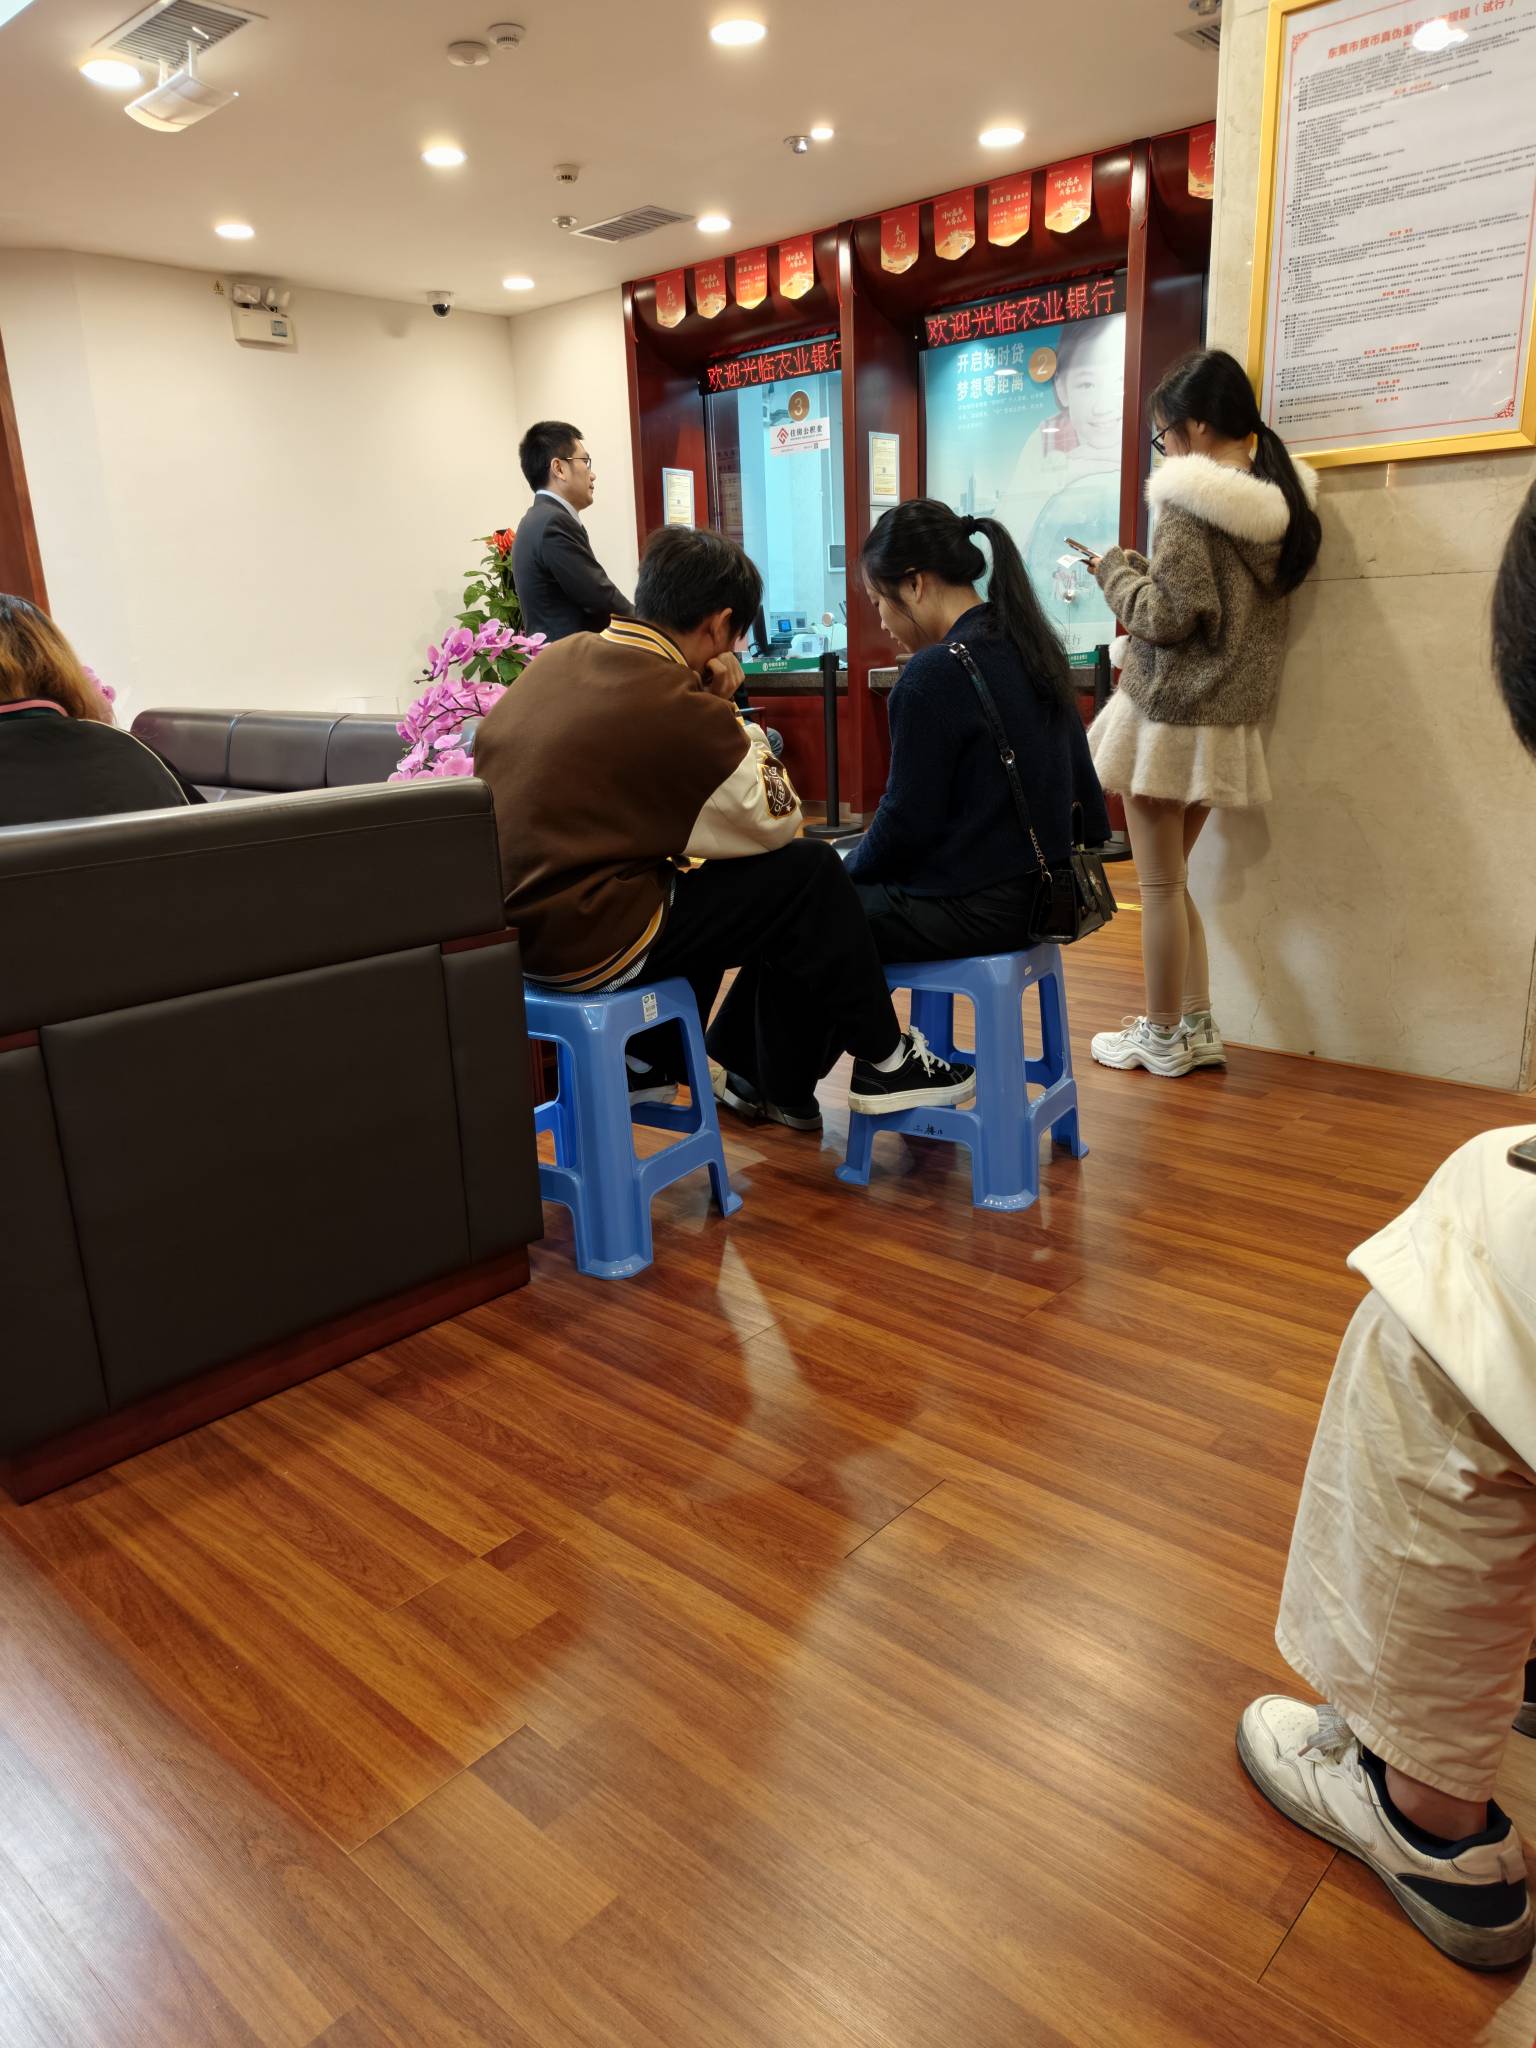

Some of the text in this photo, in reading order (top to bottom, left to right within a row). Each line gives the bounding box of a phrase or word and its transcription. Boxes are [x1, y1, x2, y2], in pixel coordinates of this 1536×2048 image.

[926, 279, 1115, 346] 欢迎光临农业银行
[707, 340, 841, 391] 欢迎光临农业银行
[957, 343, 1025, 374] 开启好时贷
[1037, 353, 1049, 376] 2
[956, 371, 1025, 401] 梦想零距离
[793, 397, 804, 416] 3
